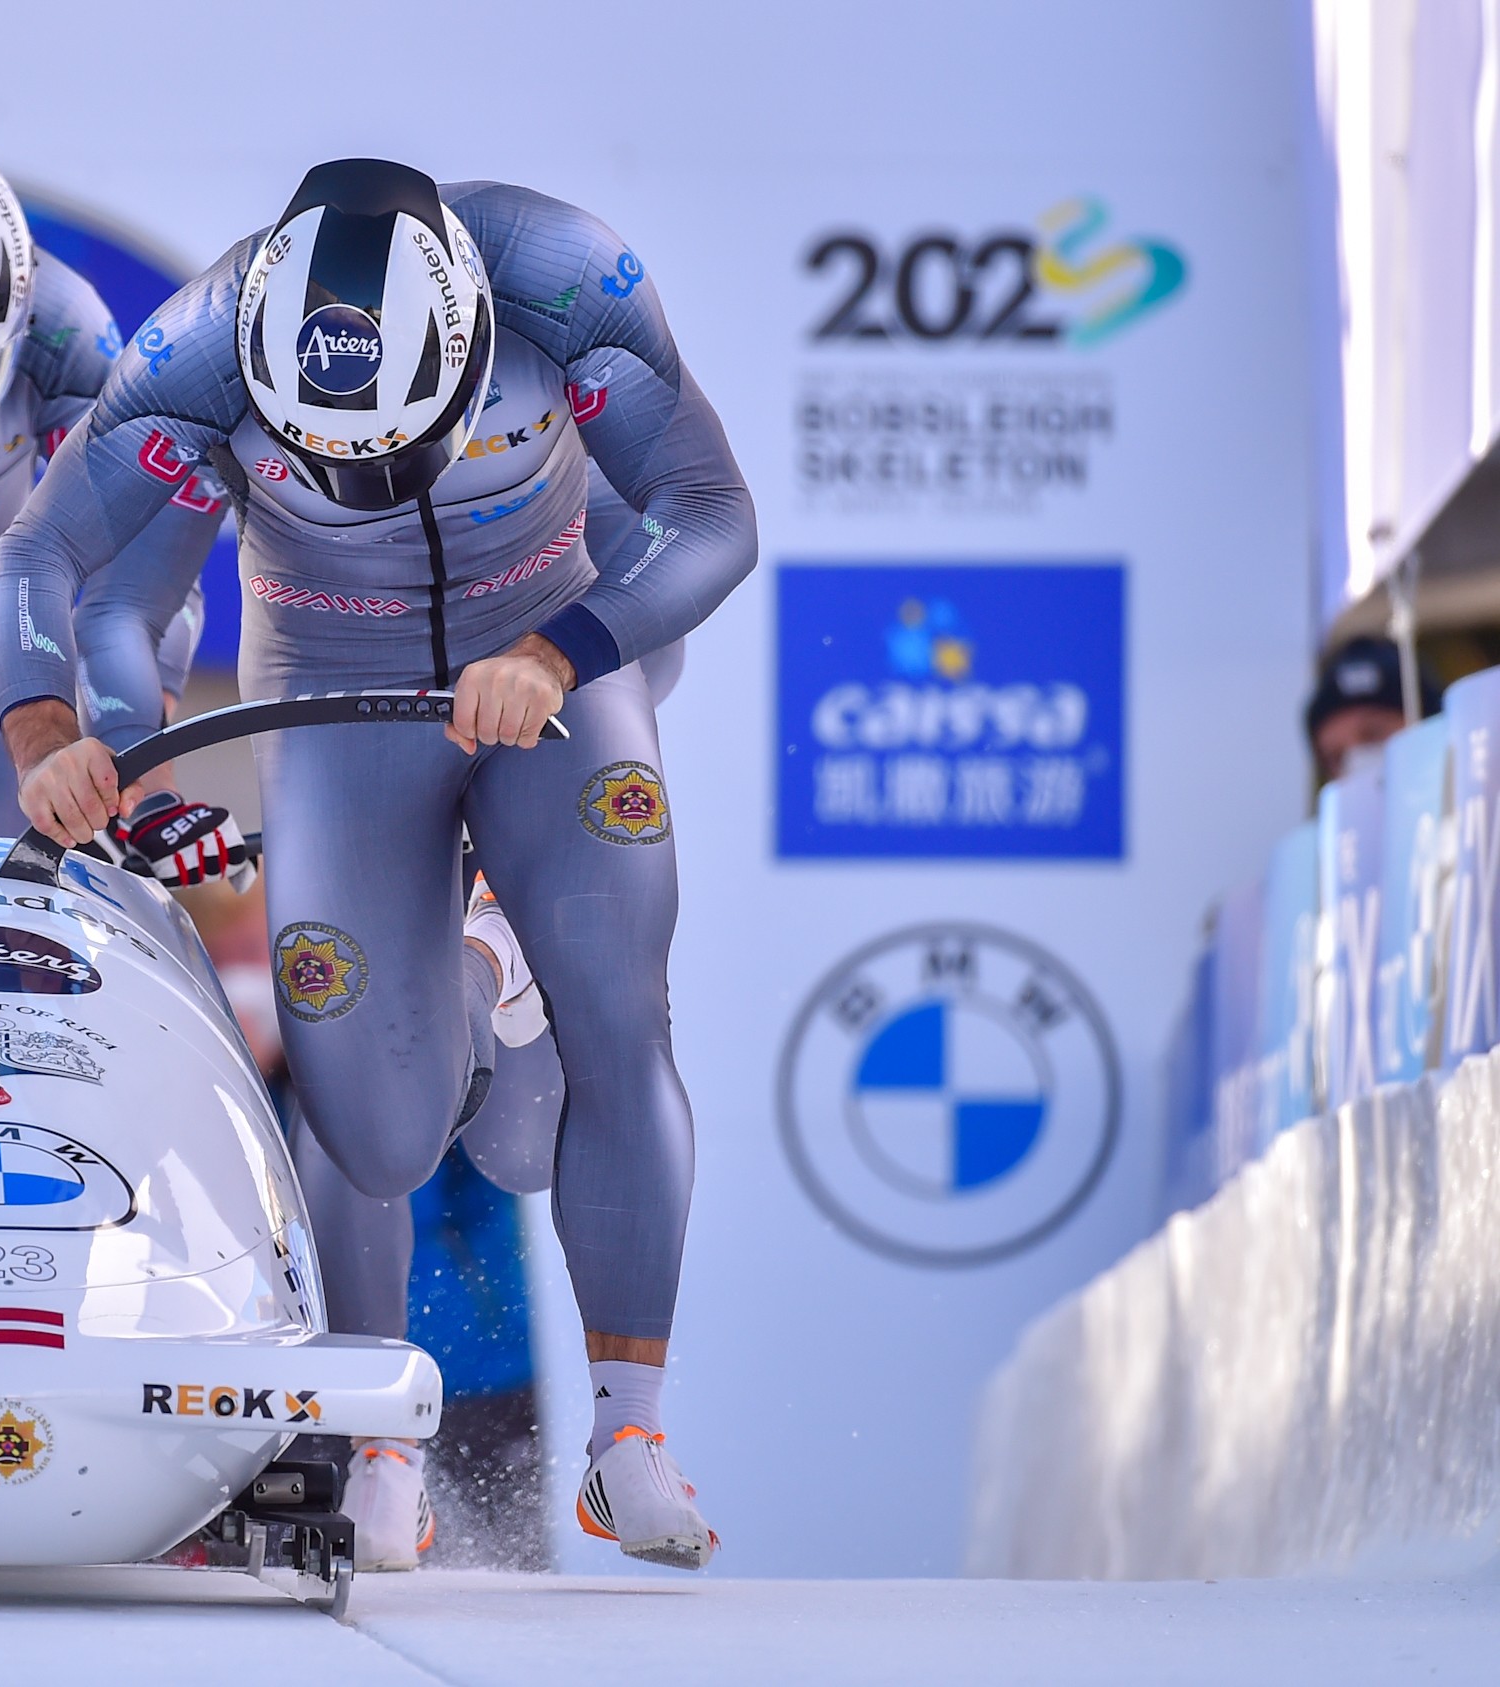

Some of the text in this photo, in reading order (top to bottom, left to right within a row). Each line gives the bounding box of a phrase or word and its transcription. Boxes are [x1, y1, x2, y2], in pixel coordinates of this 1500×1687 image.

[412, 232, 461, 329] Binders
[283, 420, 378, 456] RECK
[457, 427, 531, 461] ECK
[16, 1006, 55, 1019] OF
[57, 1017, 118, 1051] RIGA
